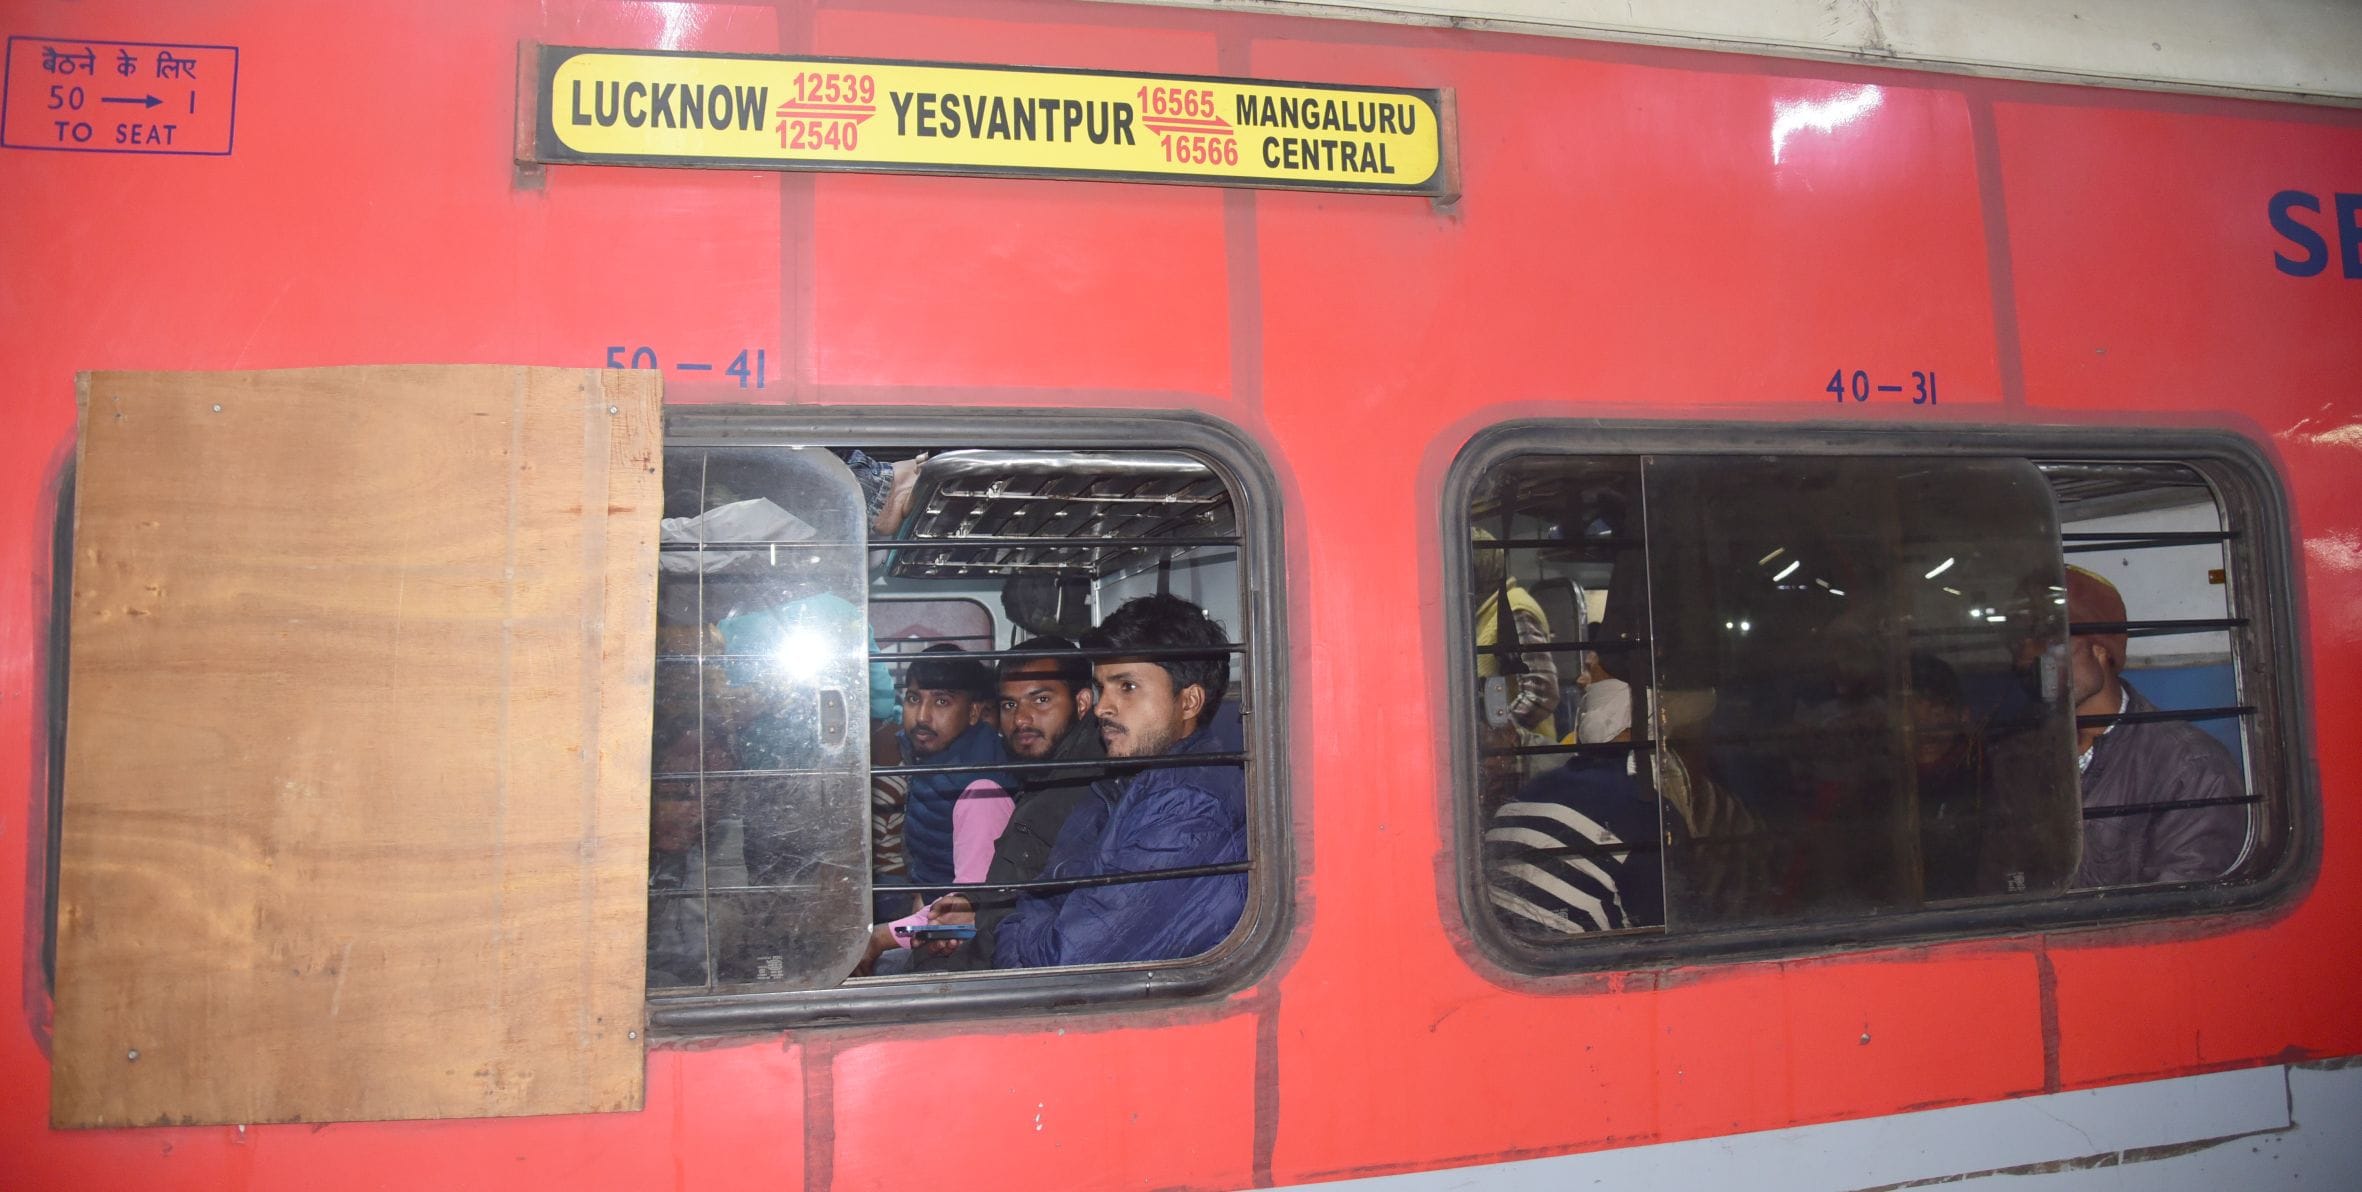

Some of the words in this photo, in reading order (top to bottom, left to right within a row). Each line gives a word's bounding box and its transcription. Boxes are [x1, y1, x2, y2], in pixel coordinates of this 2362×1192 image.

[42, 47, 96, 76] बैठने
[117, 49, 137, 77] के
[156, 51, 196, 79] लिए
[47, 85, 85, 111] 50
[792, 71, 876, 104] 12539
[1136, 85, 1215, 118] 16565
[571, 79, 768, 132] LUCKNOW
[889, 91, 1136, 146] YESVANTPUR
[1236, 94, 1416, 136] MANGALURU
[54, 121, 93, 143] TO
[115, 123, 178, 145] SEAT
[775, 119, 858, 152] 12540
[1160, 133, 1238, 167] 16566
[1262, 136, 1396, 174] CENTRAL
